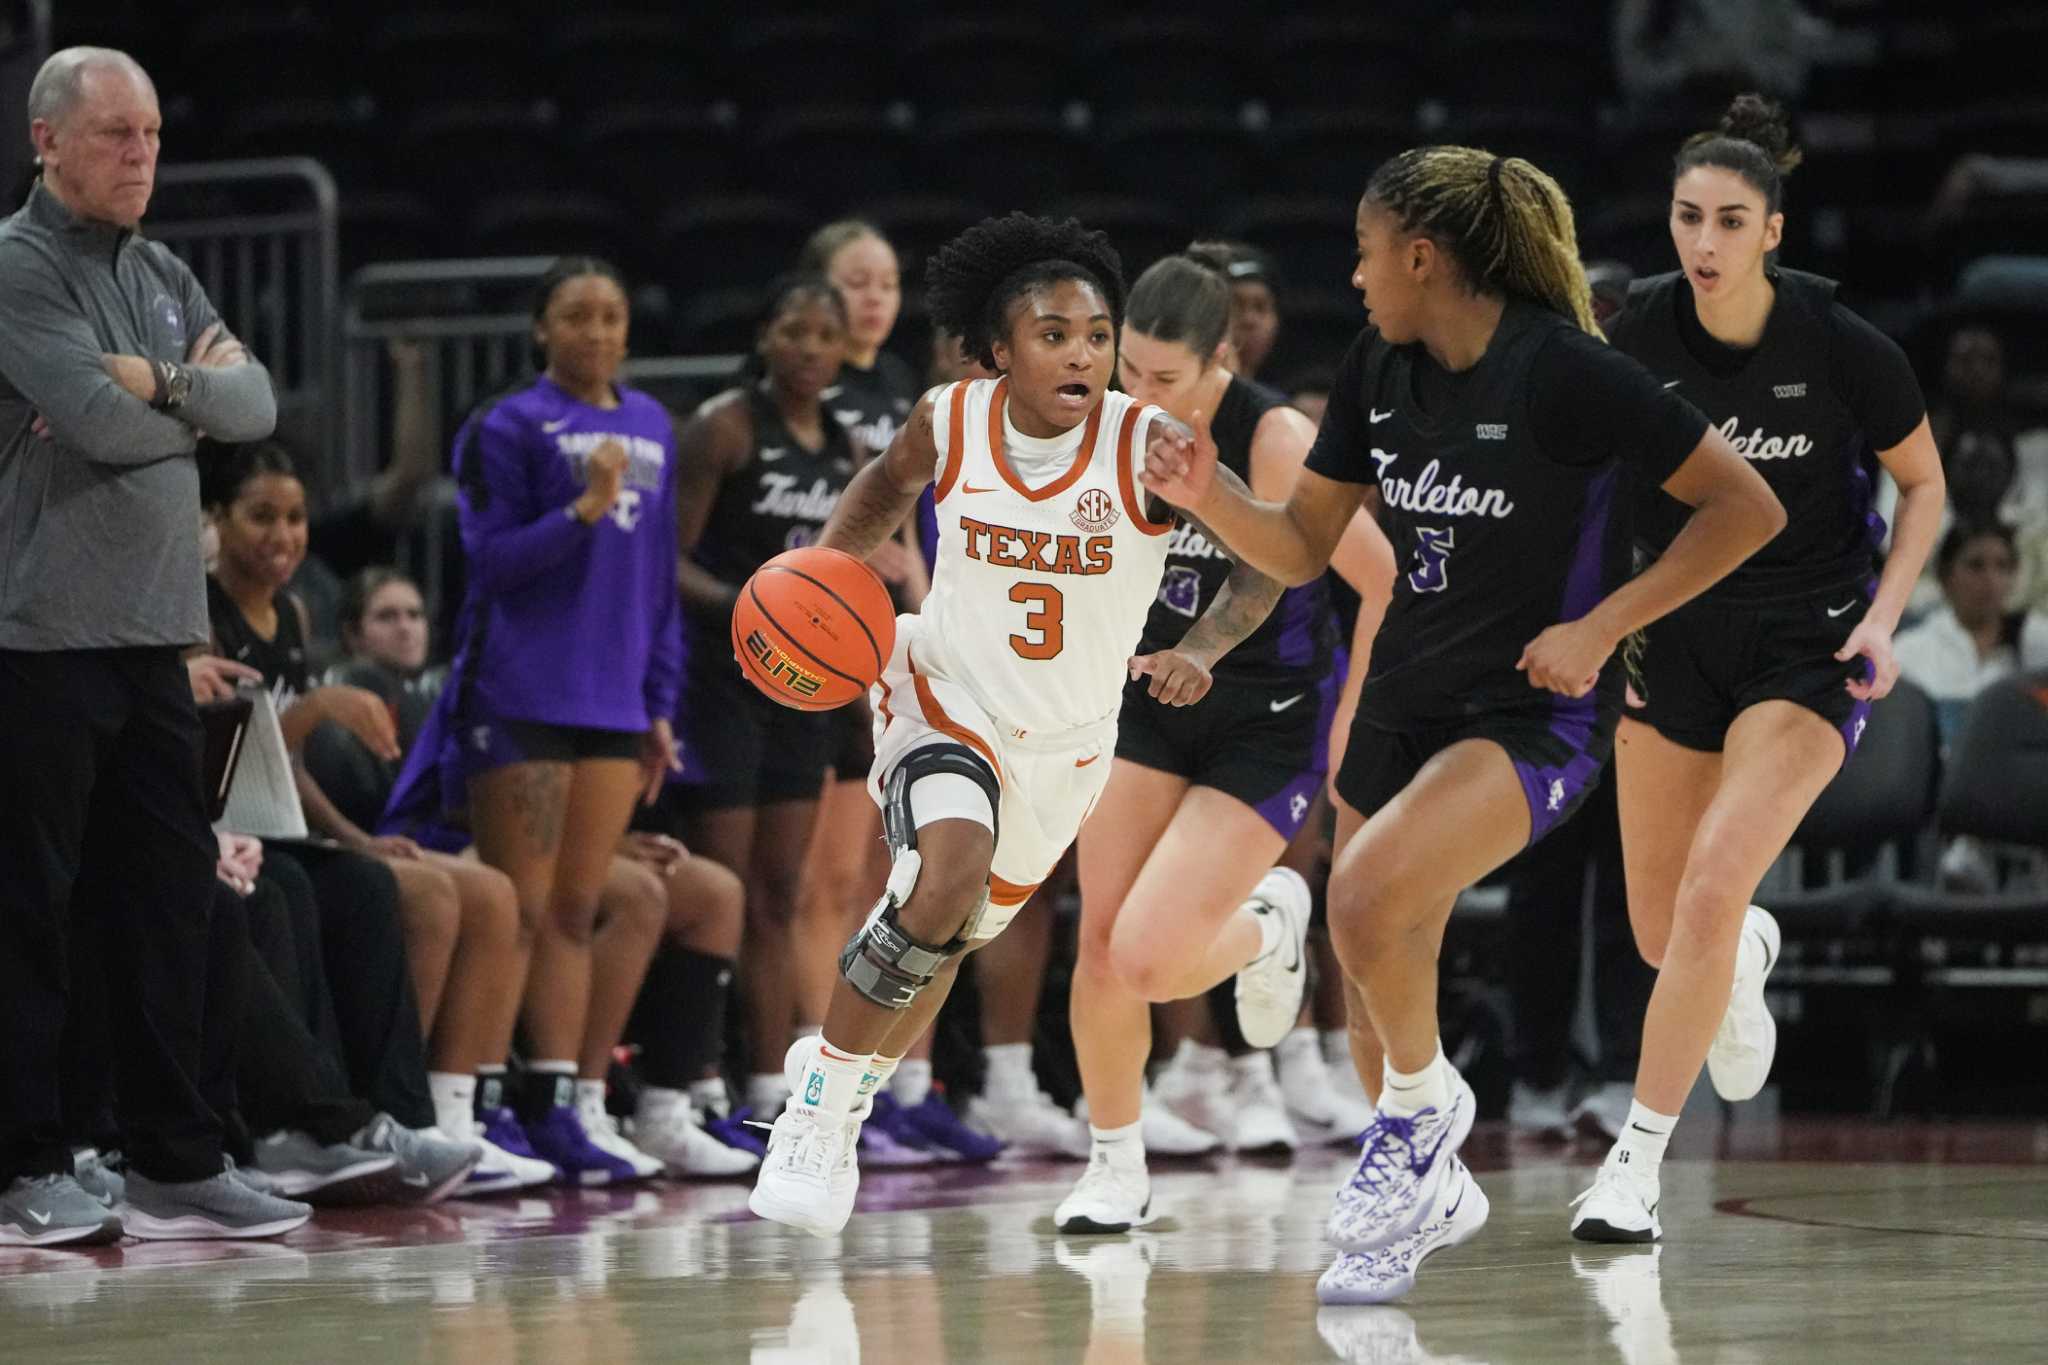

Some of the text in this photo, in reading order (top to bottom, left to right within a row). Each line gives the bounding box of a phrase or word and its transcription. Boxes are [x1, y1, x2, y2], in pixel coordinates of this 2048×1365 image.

[1718, 415, 1814, 461] leton
[1078, 489, 1113, 522] SEC
[1370, 448, 1514, 519] Tarleton
[960, 515, 1113, 575] TEXAS
[1073, 516, 1114, 533] GRADUATE
[1408, 526, 1455, 593] 5
[1008, 581, 1064, 661] 3
[746, 629, 823, 697] ELITE
